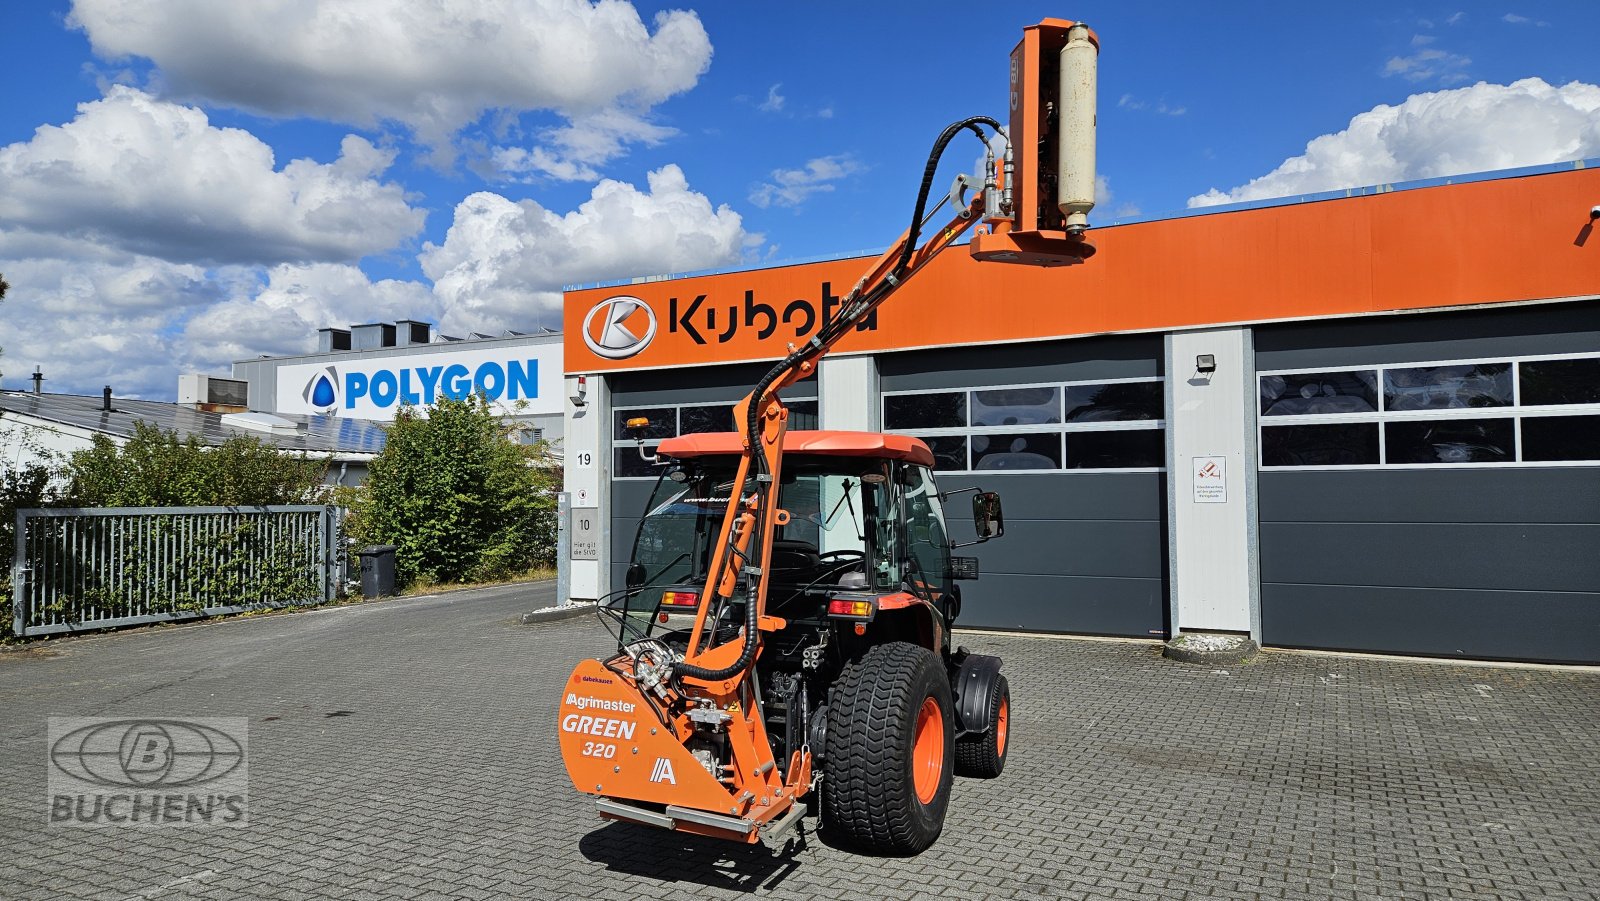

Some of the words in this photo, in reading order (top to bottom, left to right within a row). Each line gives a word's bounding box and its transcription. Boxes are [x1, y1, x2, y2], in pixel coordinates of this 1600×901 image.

[345, 359, 539, 409] POLYGON
[577, 453, 591, 466] 19
[579, 519, 590, 531] 10
[566, 693, 636, 713] Agrimaster
[562, 713, 637, 740] GREEN
[582, 741, 617, 759] 320
